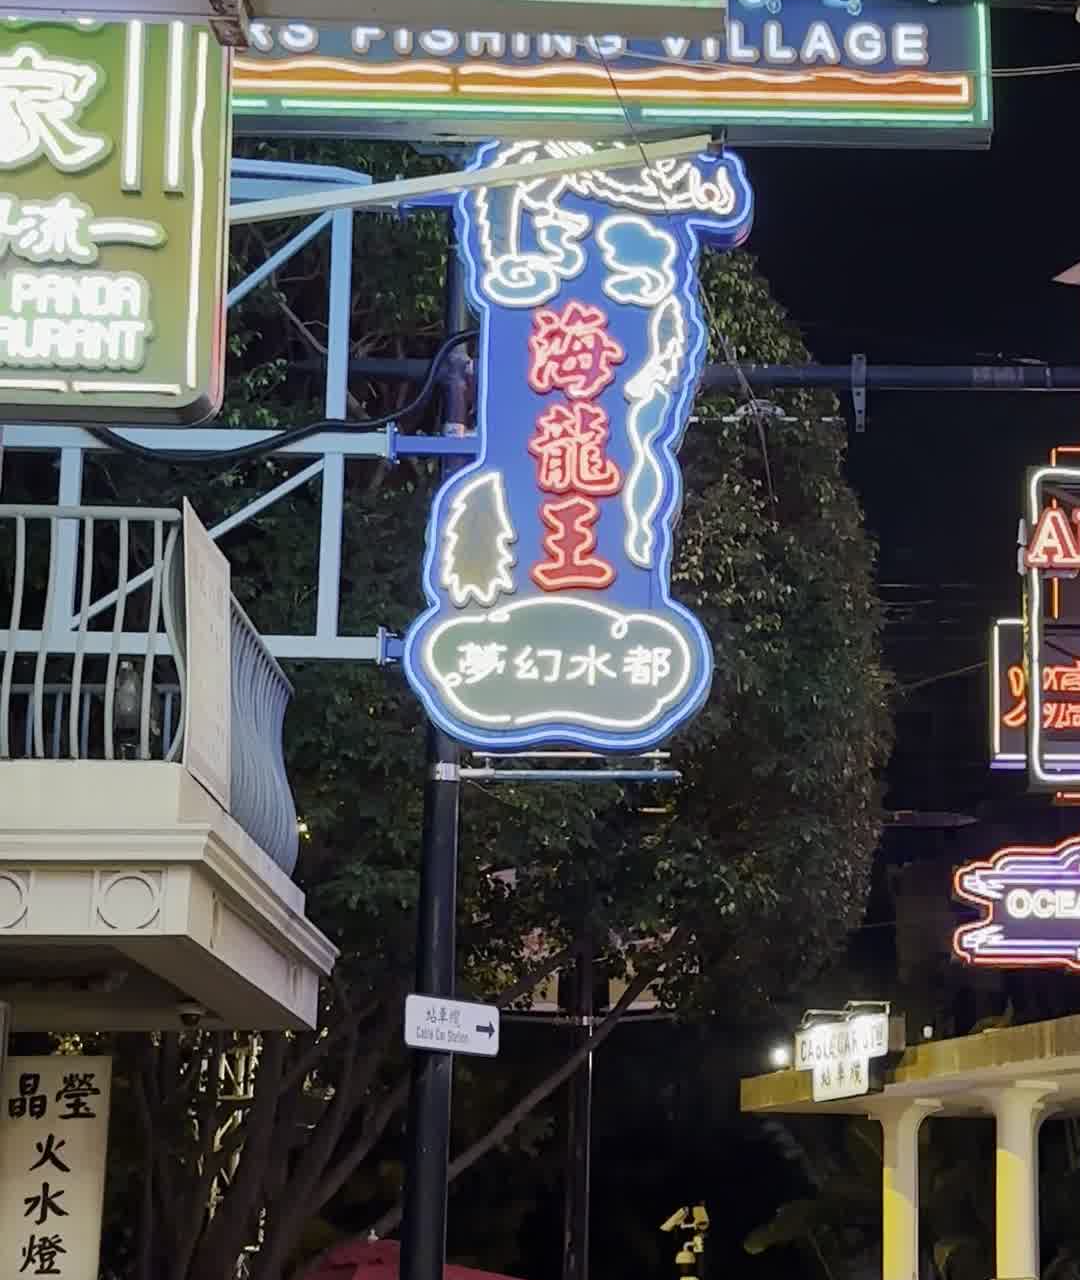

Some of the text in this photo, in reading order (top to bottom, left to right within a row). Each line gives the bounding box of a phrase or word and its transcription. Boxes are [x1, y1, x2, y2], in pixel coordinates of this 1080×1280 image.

[659, 21, 927, 65] VILLAGE
[11, 272, 142, 316] PANDA
[530, 302, 626, 590] 海龍王
[457, 643, 673, 688] 夢幻水都
[19, 1132, 72, 1275] 火水燈
